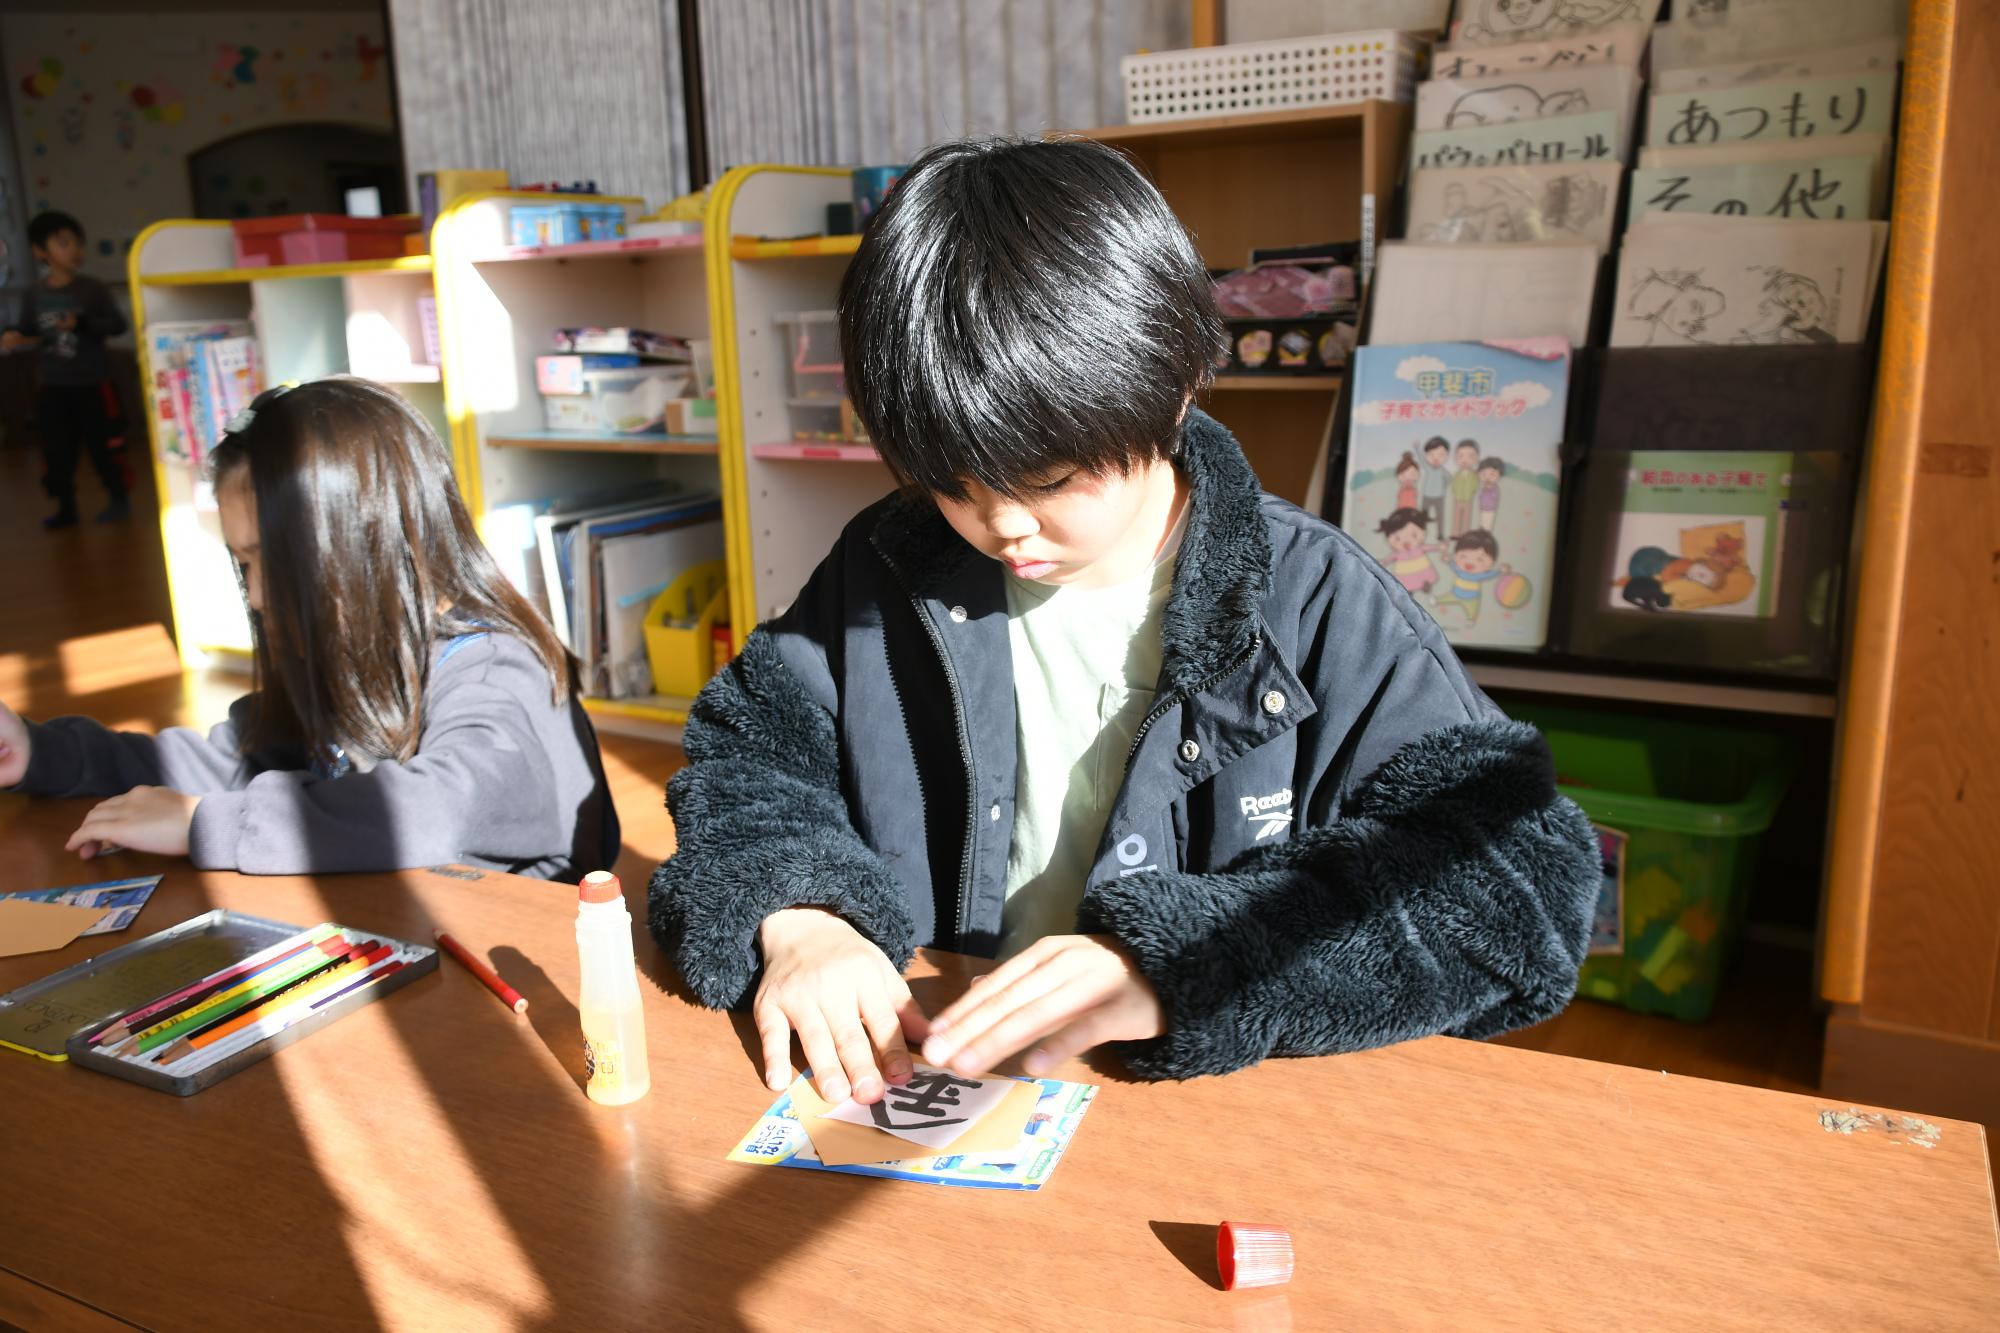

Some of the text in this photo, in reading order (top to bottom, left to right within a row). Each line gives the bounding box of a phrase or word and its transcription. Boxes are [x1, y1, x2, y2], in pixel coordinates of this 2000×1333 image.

[1667, 86, 1867, 144] あつもり
[1648, 168, 1845, 219] その他
[1417, 369, 1493, 399] 甲斐市
[1381, 398, 1527, 421] 子育てガイドブック
[1240, 787, 1293, 816] Reeb
[745, 1124, 777, 1154] 見たこと
